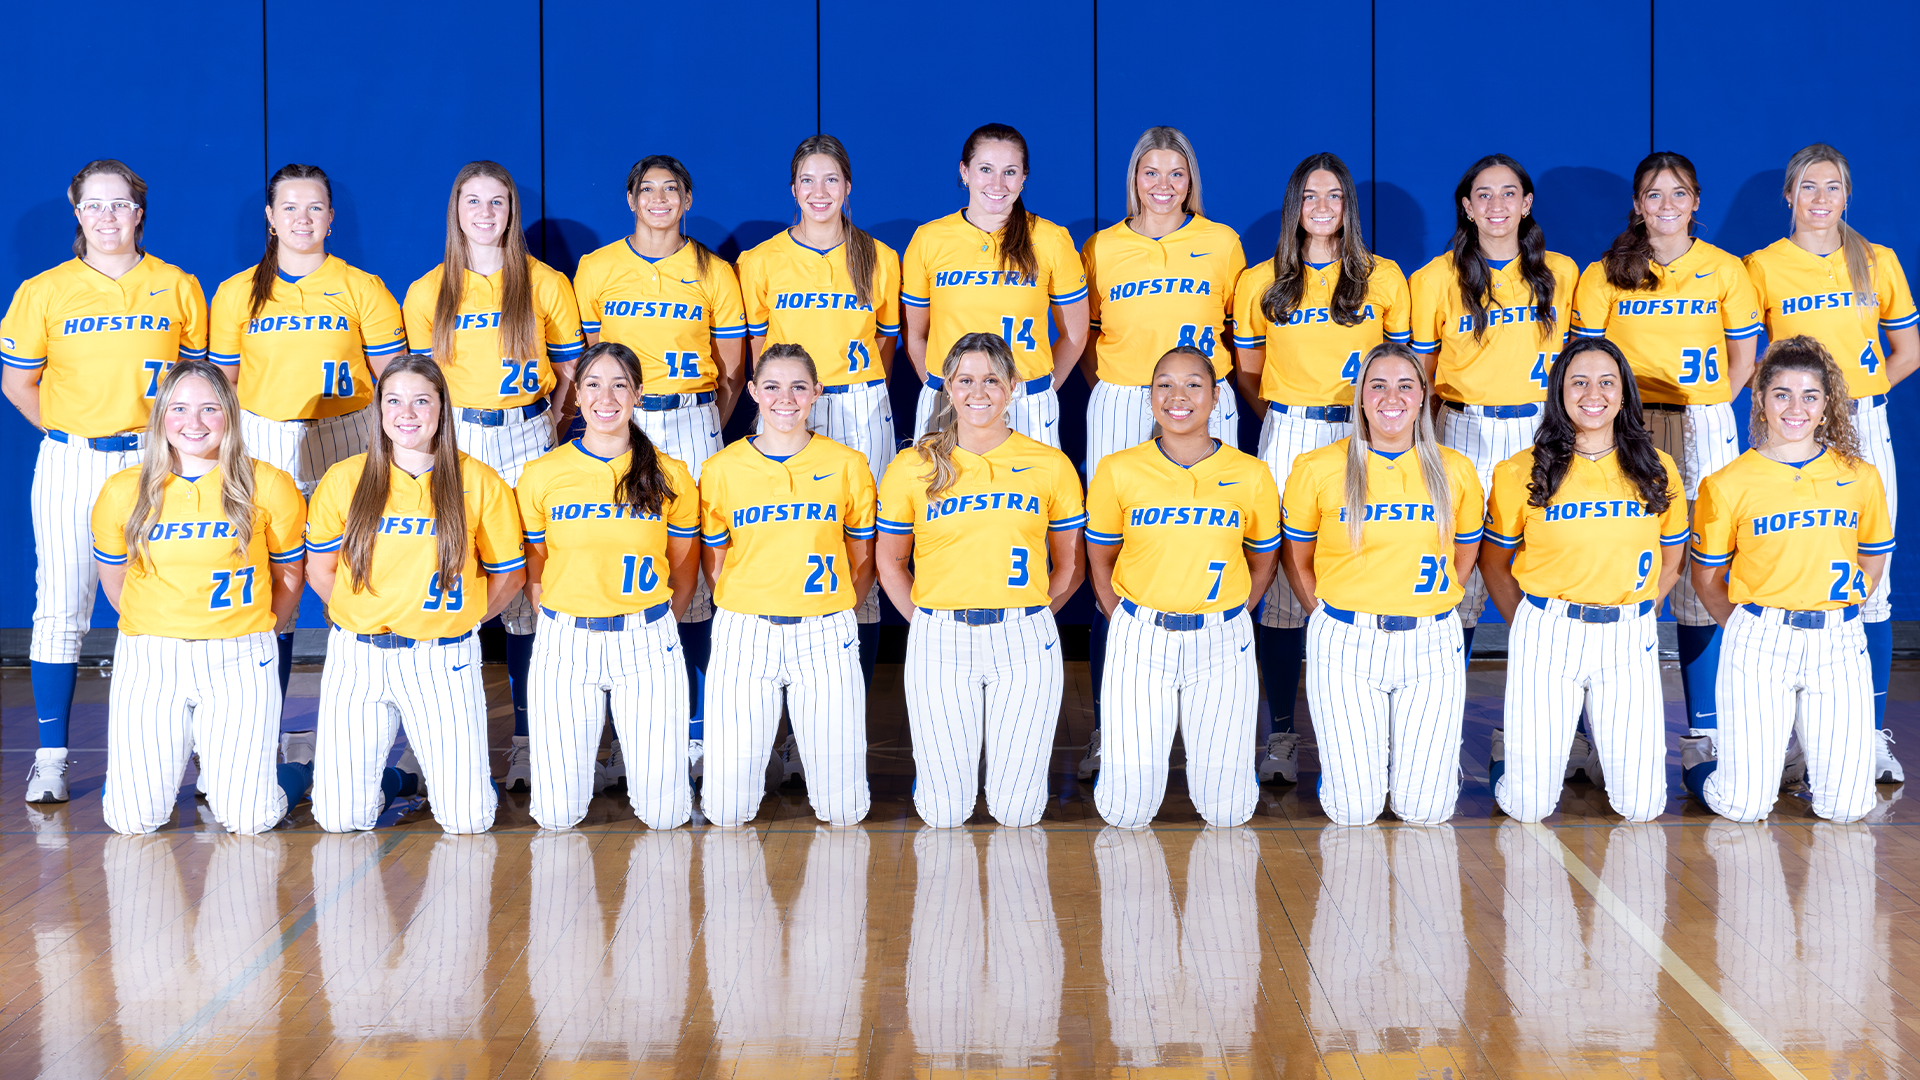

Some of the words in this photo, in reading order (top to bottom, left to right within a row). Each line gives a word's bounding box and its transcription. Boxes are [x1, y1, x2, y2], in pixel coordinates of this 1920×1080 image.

[935, 270, 1037, 288] HOFSTRA
[1109, 278, 1211, 301] HOFSTRA
[63, 314, 171, 336] HOFSTRA
[246, 315, 350, 336] HOFSTRA
[603, 300, 704, 321] HOFSTRA
[1274, 304, 1375, 327] OFSA
[1618, 299, 1718, 317] HOFSTRA
[1001, 315, 1037, 352] 14
[665, 352, 704, 379] 15
[847, 339, 871, 374] 11
[1530, 352, 1561, 389] 4
[1678, 346, 1720, 385] 36
[1859, 339, 1880, 375] 4
[142, 360, 175, 400] 7
[322, 361, 354, 400] 18
[498, 359, 541, 396] 26
[732, 502, 838, 529] HOFSTRA
[926, 492, 1041, 523] HOFSTRA
[1130, 506, 1241, 529] HOFSTRA
[1338, 503, 1437, 523] OFSTR
[1753, 508, 1859, 537] HOFSTRA
[138, 520, 240, 543] OFSTR
[620, 553, 660, 596] 10
[803, 553, 839, 595] 21
[1006, 546, 1030, 588] 3
[1205, 560, 1229, 602] 7
[1412, 553, 1450, 596] 31
[1632, 550, 1654, 592] 9
[1828, 561, 1868, 602] 24
[207, 564, 257, 612] 27
[421, 571, 464, 613] 99
